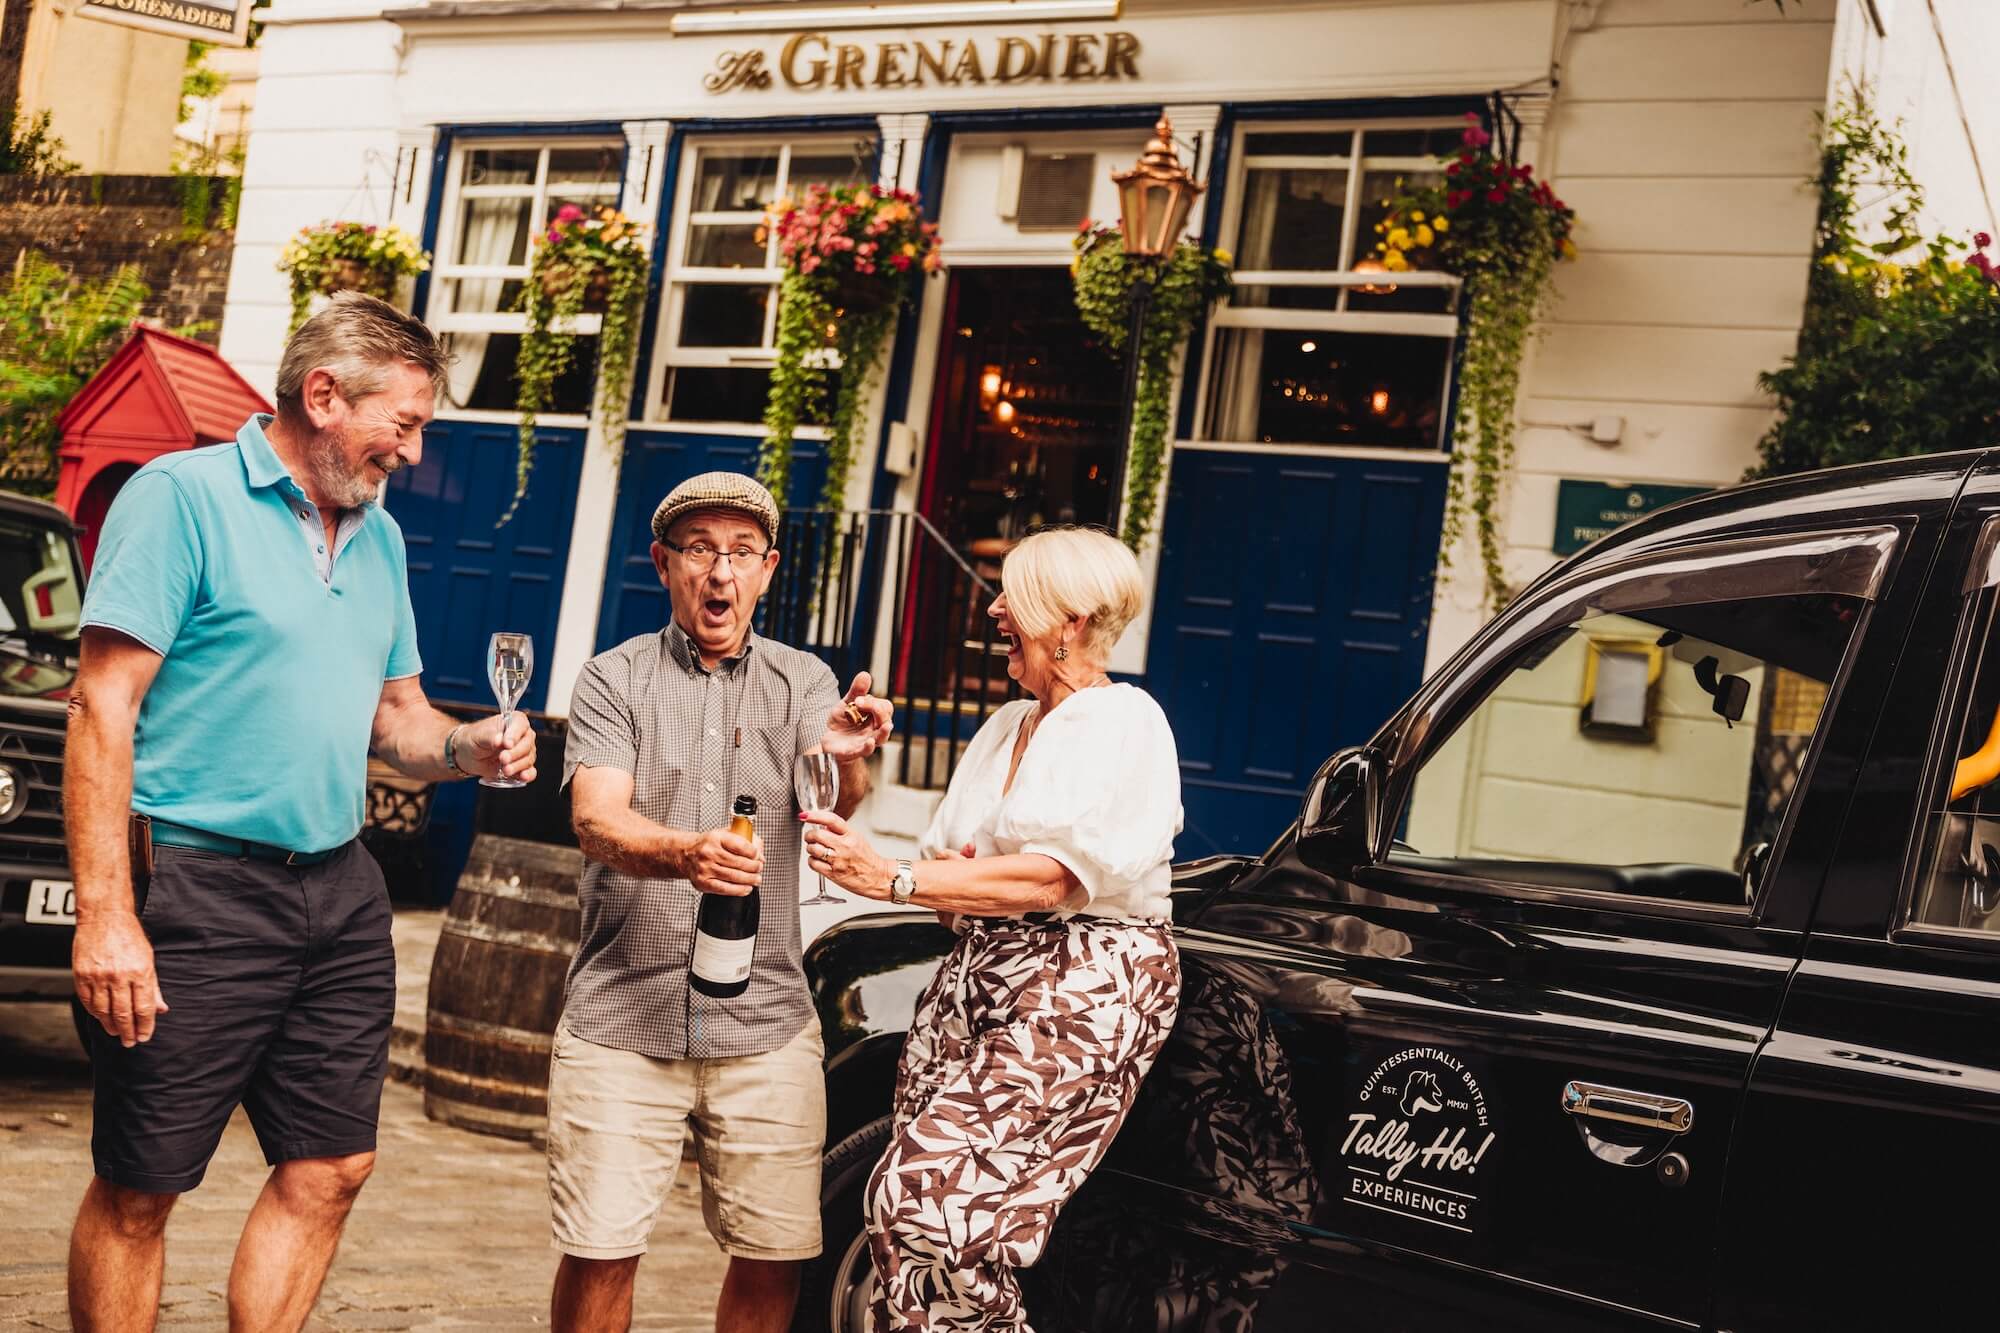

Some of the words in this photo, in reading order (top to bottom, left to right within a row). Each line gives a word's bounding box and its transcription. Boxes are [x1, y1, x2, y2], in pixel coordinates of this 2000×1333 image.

[704, 49, 773, 94] The
[779, 31, 1142, 91] GRENADIER
[1360, 1047, 1464, 1101] QUINTESSENTIALLY
[1462, 1071, 1488, 1127] BRITISH
[1382, 1085, 1398, 1096] EST.
[1446, 1099, 1469, 1110] MMXI
[1341, 1113, 1420, 1181] Tally
[1421, 1127, 1495, 1174] Ho!
[1352, 1178, 1467, 1220] EXPERIENCES
